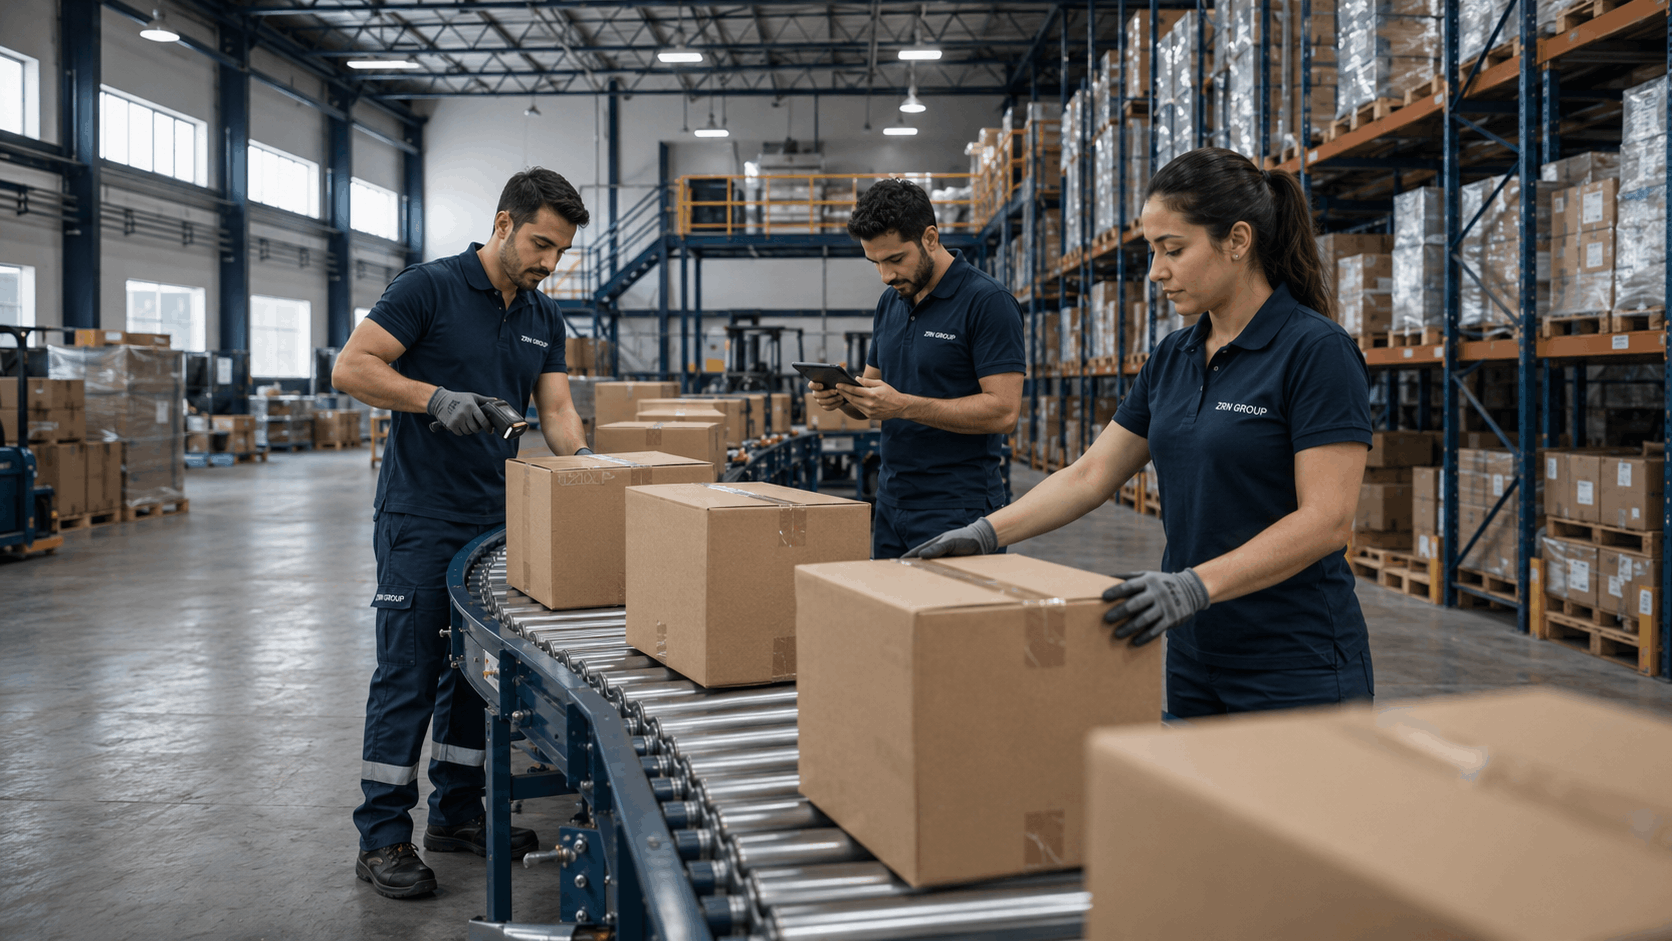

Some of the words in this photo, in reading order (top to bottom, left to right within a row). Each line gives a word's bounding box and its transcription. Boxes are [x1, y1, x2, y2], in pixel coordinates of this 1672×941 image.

[935, 332, 956, 340] GROUP
[1215, 401, 1234, 411] ZRN
[1233, 403, 1268, 416] GROUP
[383, 594, 405, 603] GROUP
